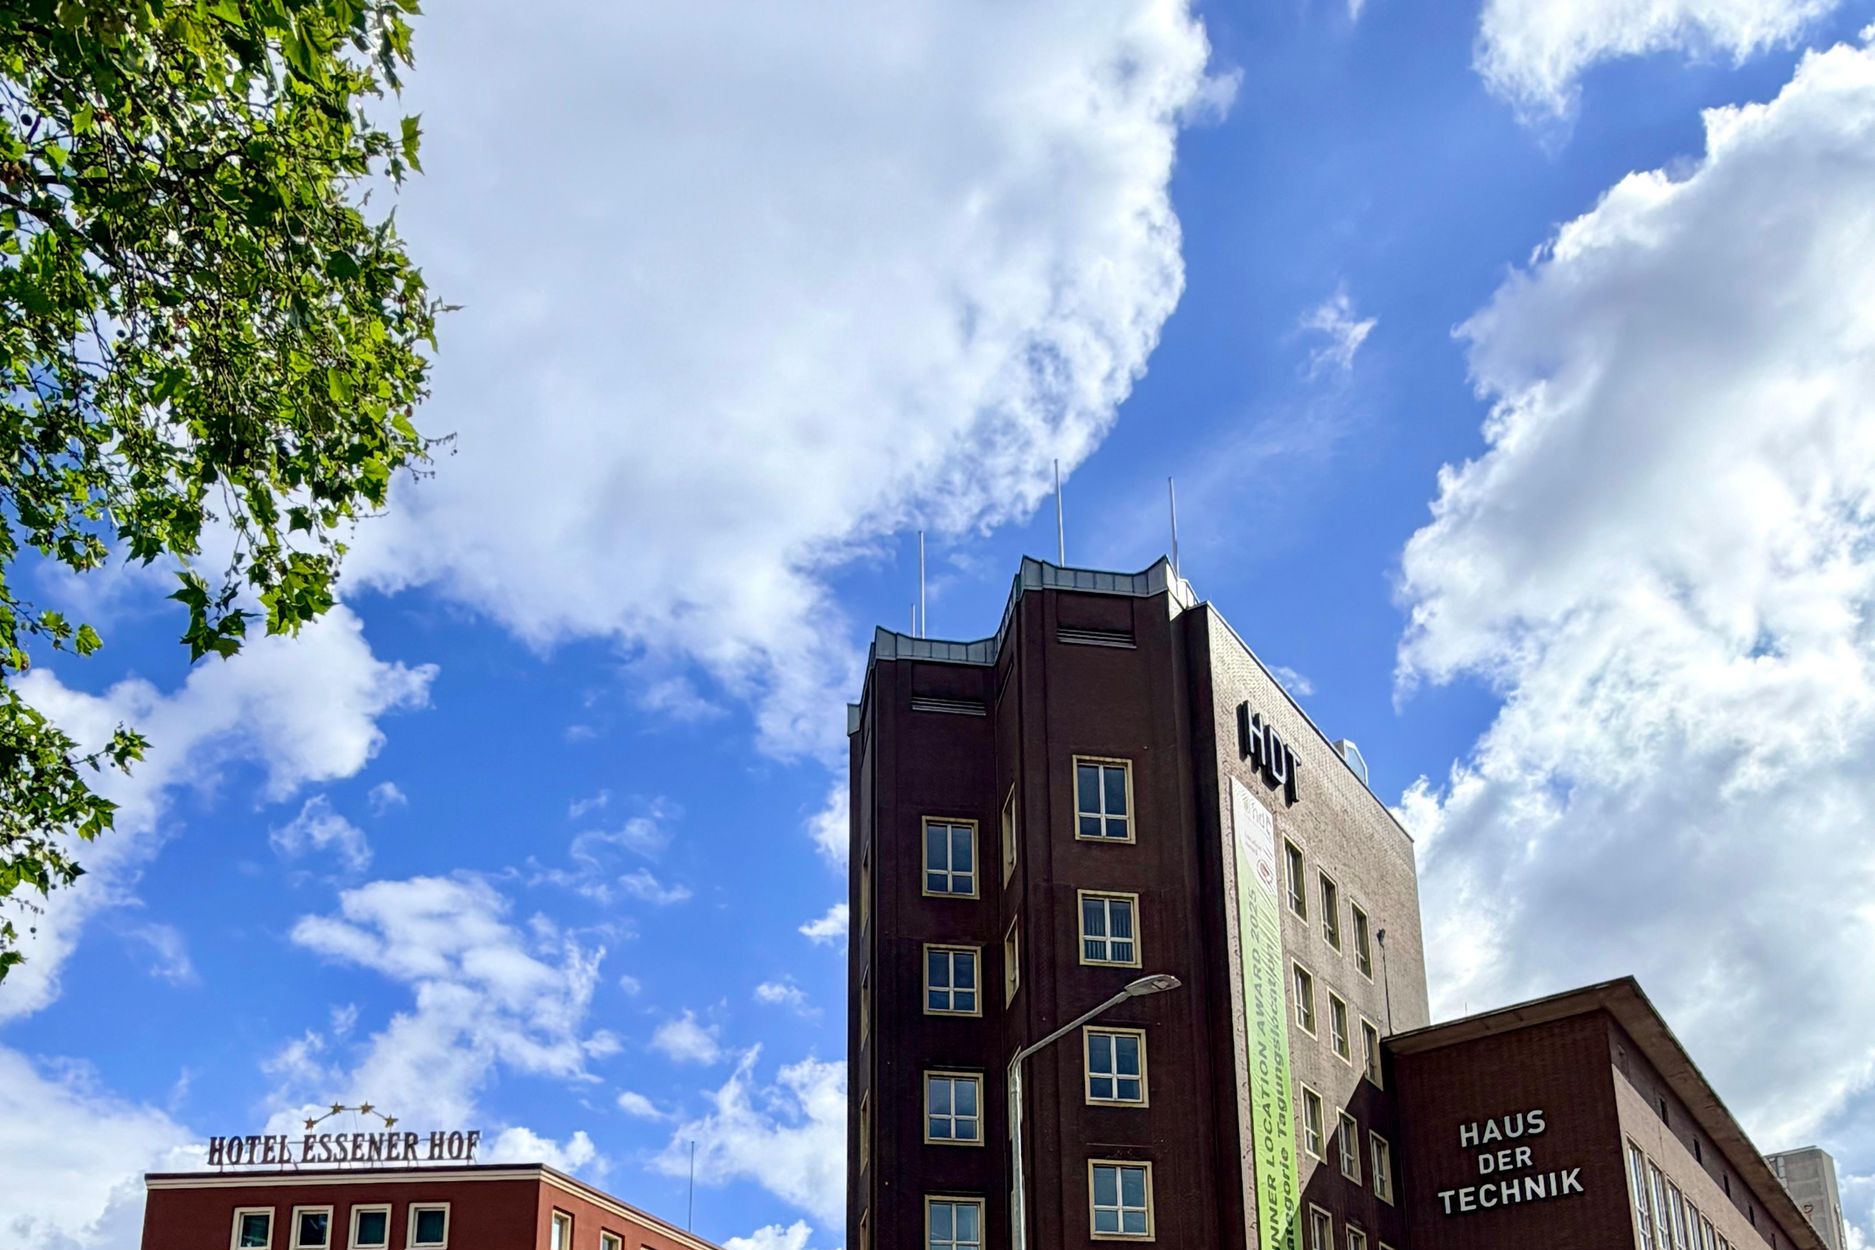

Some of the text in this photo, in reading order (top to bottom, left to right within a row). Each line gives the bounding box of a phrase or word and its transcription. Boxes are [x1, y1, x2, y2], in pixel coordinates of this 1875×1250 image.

[1245, 699, 1302, 804] HDT
[1248, 886, 1260, 944] 2025
[1252, 949, 1266, 1036] AWARD
[1265, 942, 1288, 1139] Tagungslocation
[1259, 1041, 1280, 1168] LOCATION
[1460, 1110, 1546, 1147] HAUS
[207, 1130, 481, 1166] HOTEL ESSENER HOF
[1478, 1146, 1533, 1174] DER
[1437, 1167, 1585, 1215] TECHNIK
